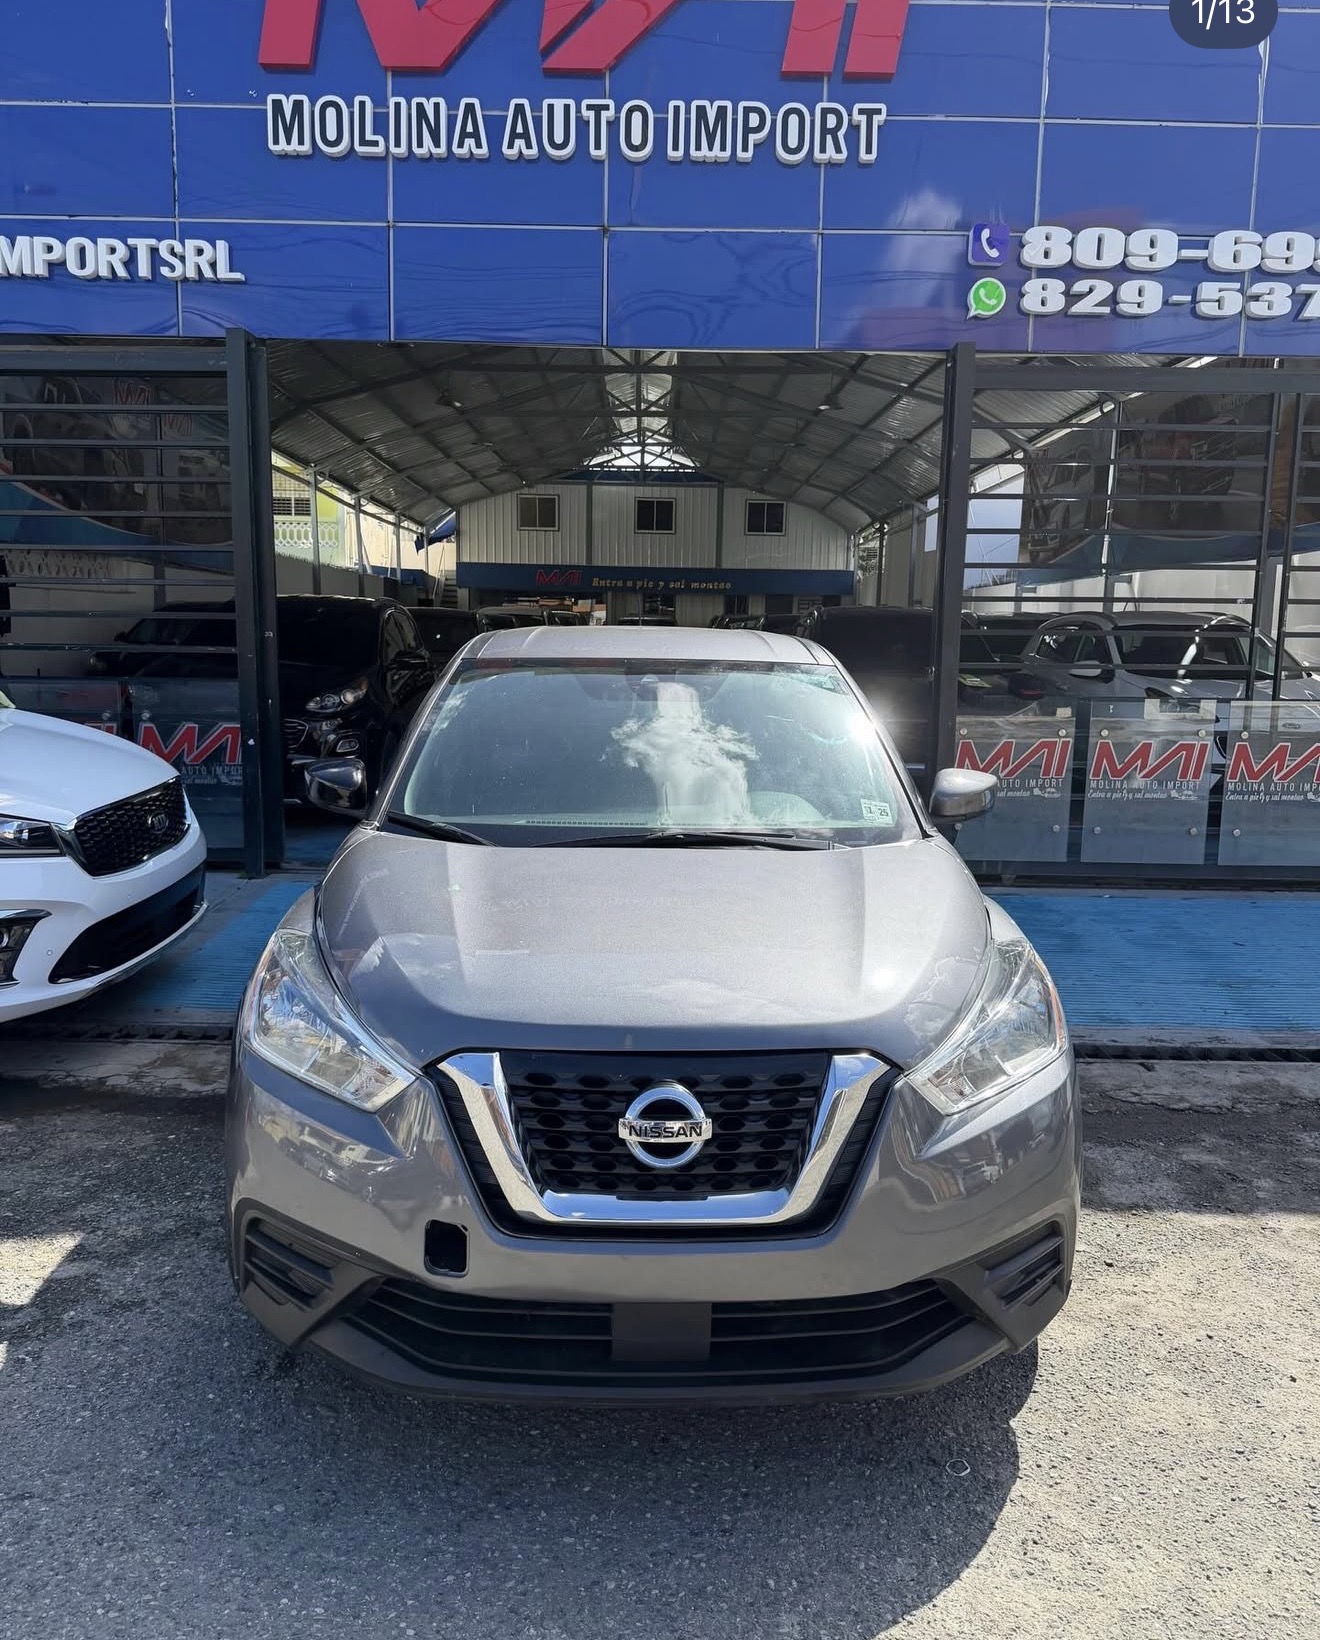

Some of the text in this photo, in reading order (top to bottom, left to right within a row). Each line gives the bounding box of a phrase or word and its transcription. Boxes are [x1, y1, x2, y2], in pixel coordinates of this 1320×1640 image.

[267, 93, 887, 164] MOLINA AUTO IMPORT
[1020, 226, 1320, 273] 809-69
[535, 569, 583, 586] MAI
[955, 738, 1073, 779] MAI
[1089, 740, 1210, 781] MAI
[1025, 779, 1062, 788] IMPORT
[1090, 780, 1200, 790] MOLINA AUTO IMPORT
[1228, 783, 1265, 792] MOLINA
[1270, 783, 1295, 792] AUTO
[877, 808, 889, 817] 25
[629, 1125, 702, 1138] NISSAN
